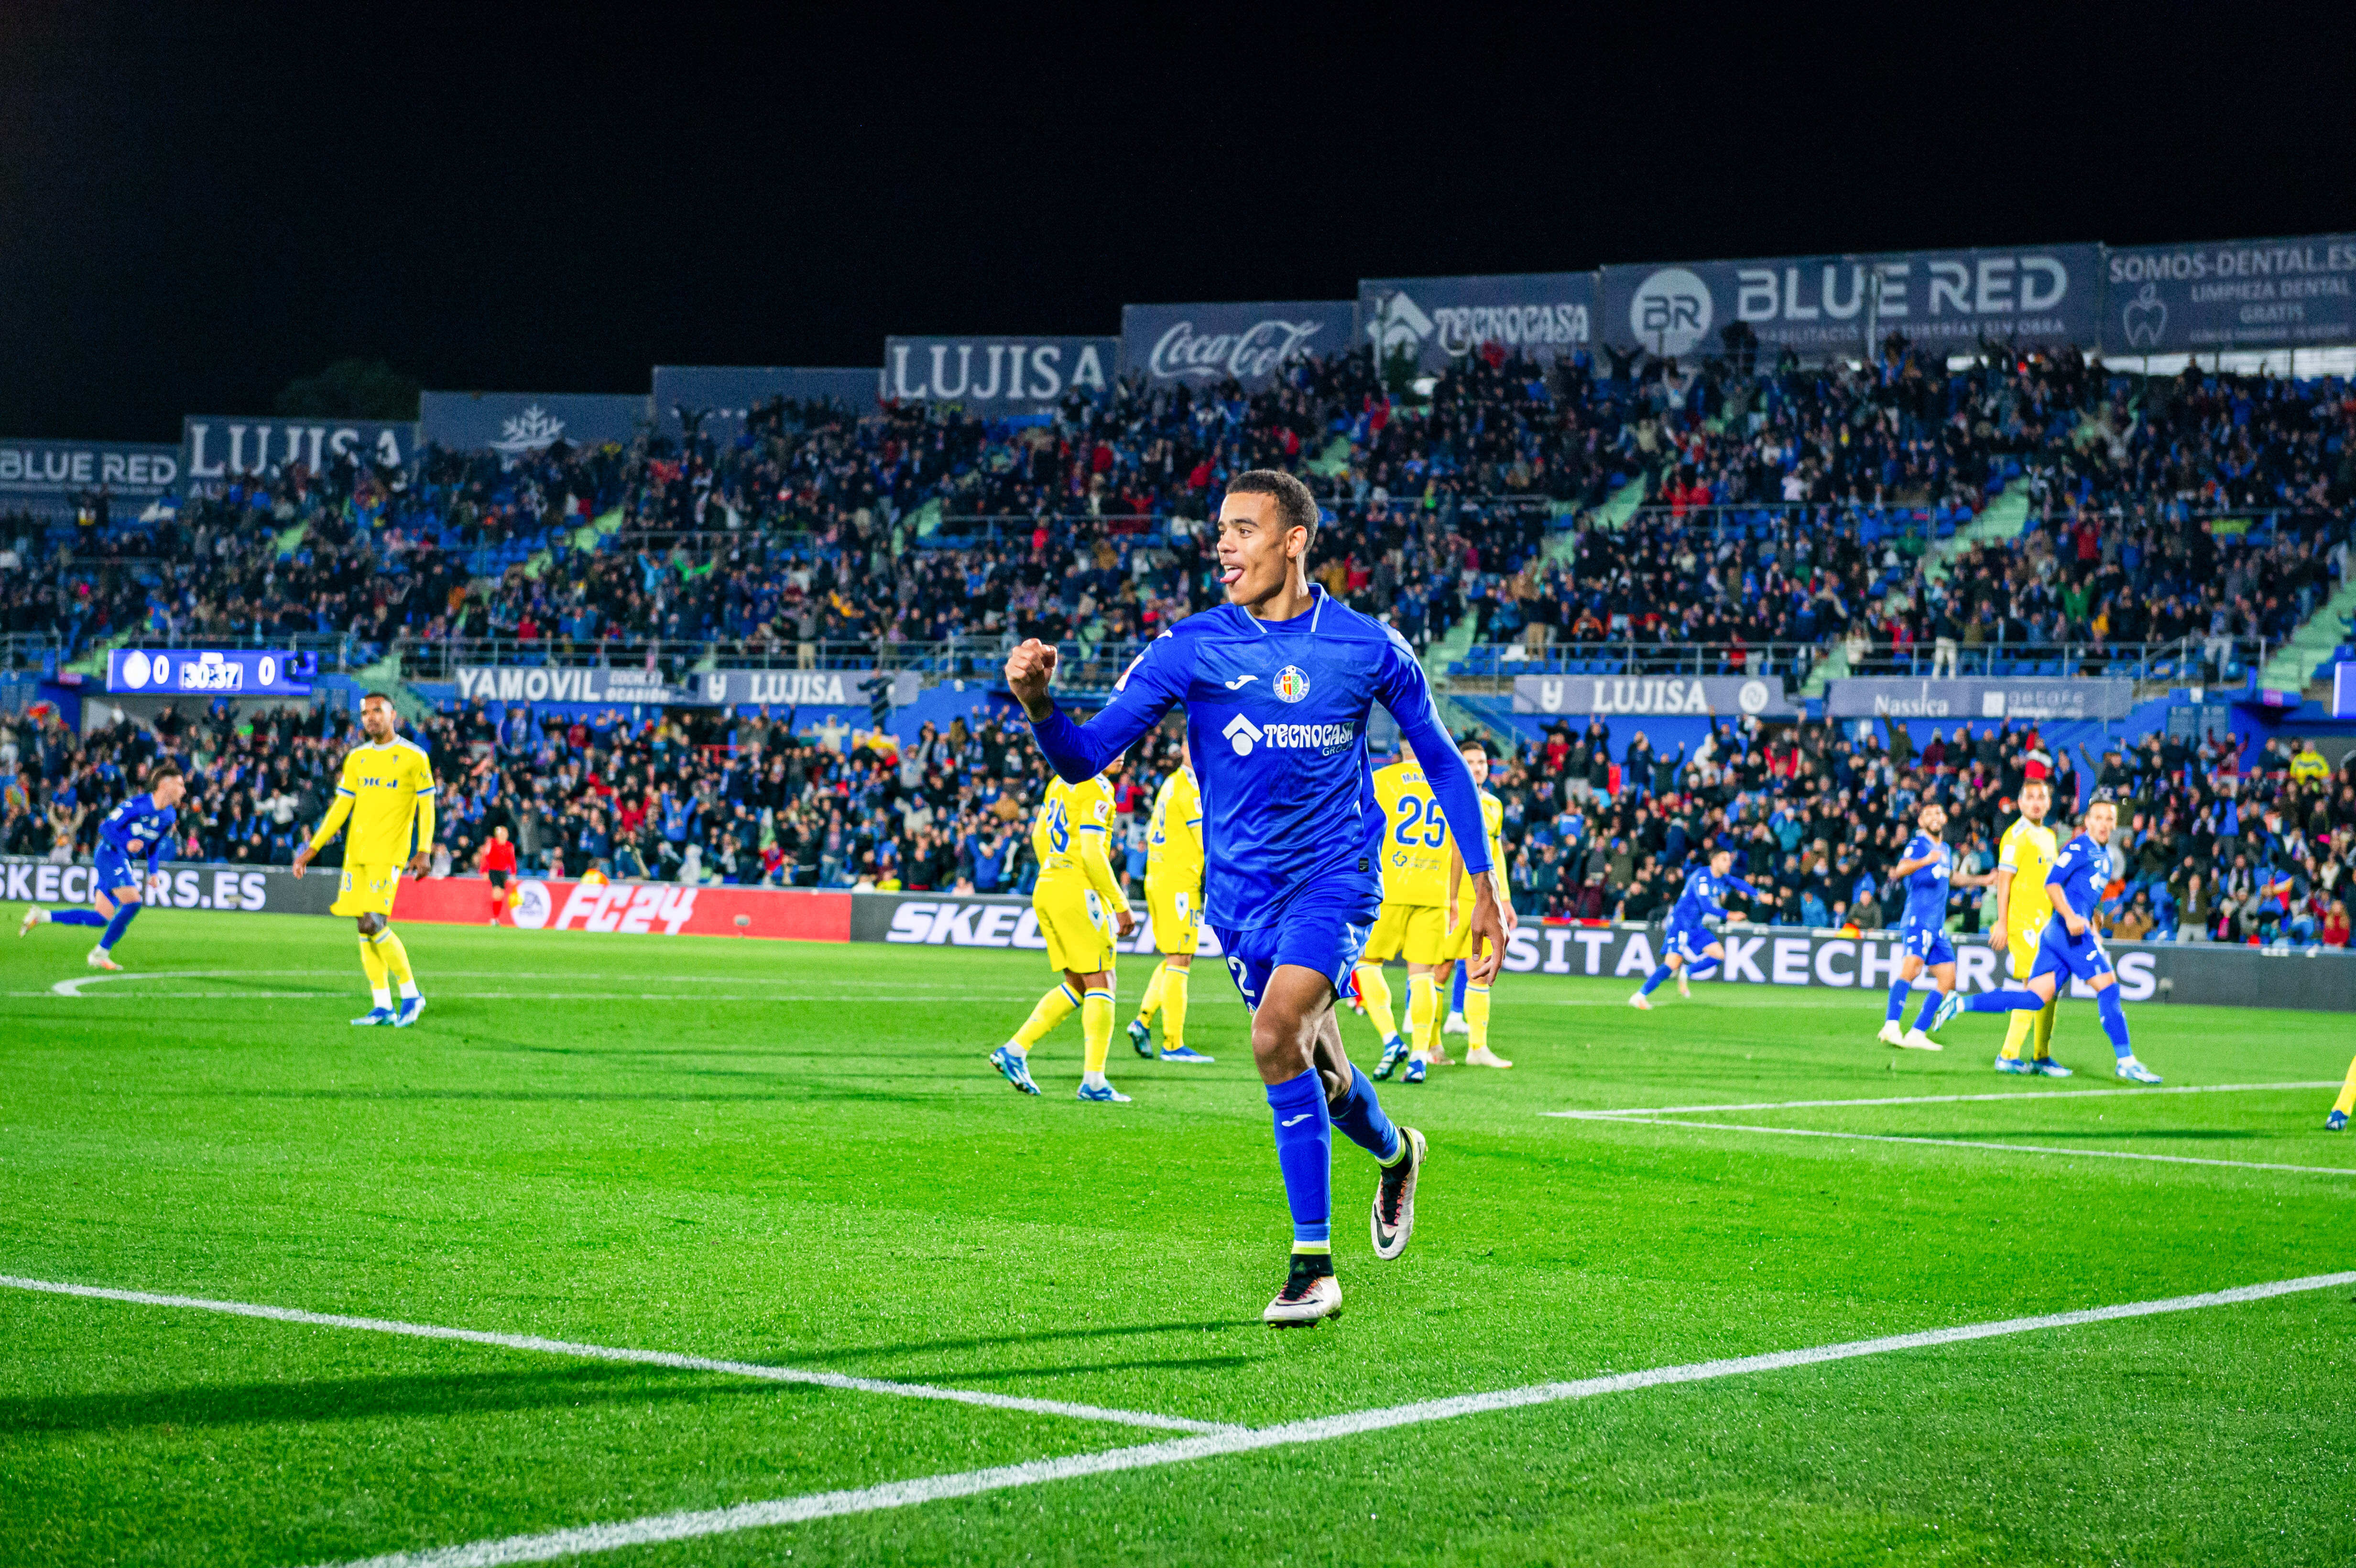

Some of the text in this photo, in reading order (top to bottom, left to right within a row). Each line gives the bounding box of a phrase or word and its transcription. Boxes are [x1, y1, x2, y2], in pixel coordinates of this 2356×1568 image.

[1736, 256, 2068, 321] BLUE RED
[892, 345, 1107, 399] LUJISA
[102, 454, 177, 485] RED
[153, 655, 170, 685] 0
[258, 656, 275, 686] 0
[458, 669, 600, 701] YAMOVIL
[750, 674, 846, 705] LUJISA
[1592, 680, 1708, 713] LUJISA
[1874, 693, 1949, 716] Nassica
[1263, 721, 1355, 748] TECNOCASA
[1395, 795, 1446, 848] 25
[1227, 956, 1255, 997] 2
